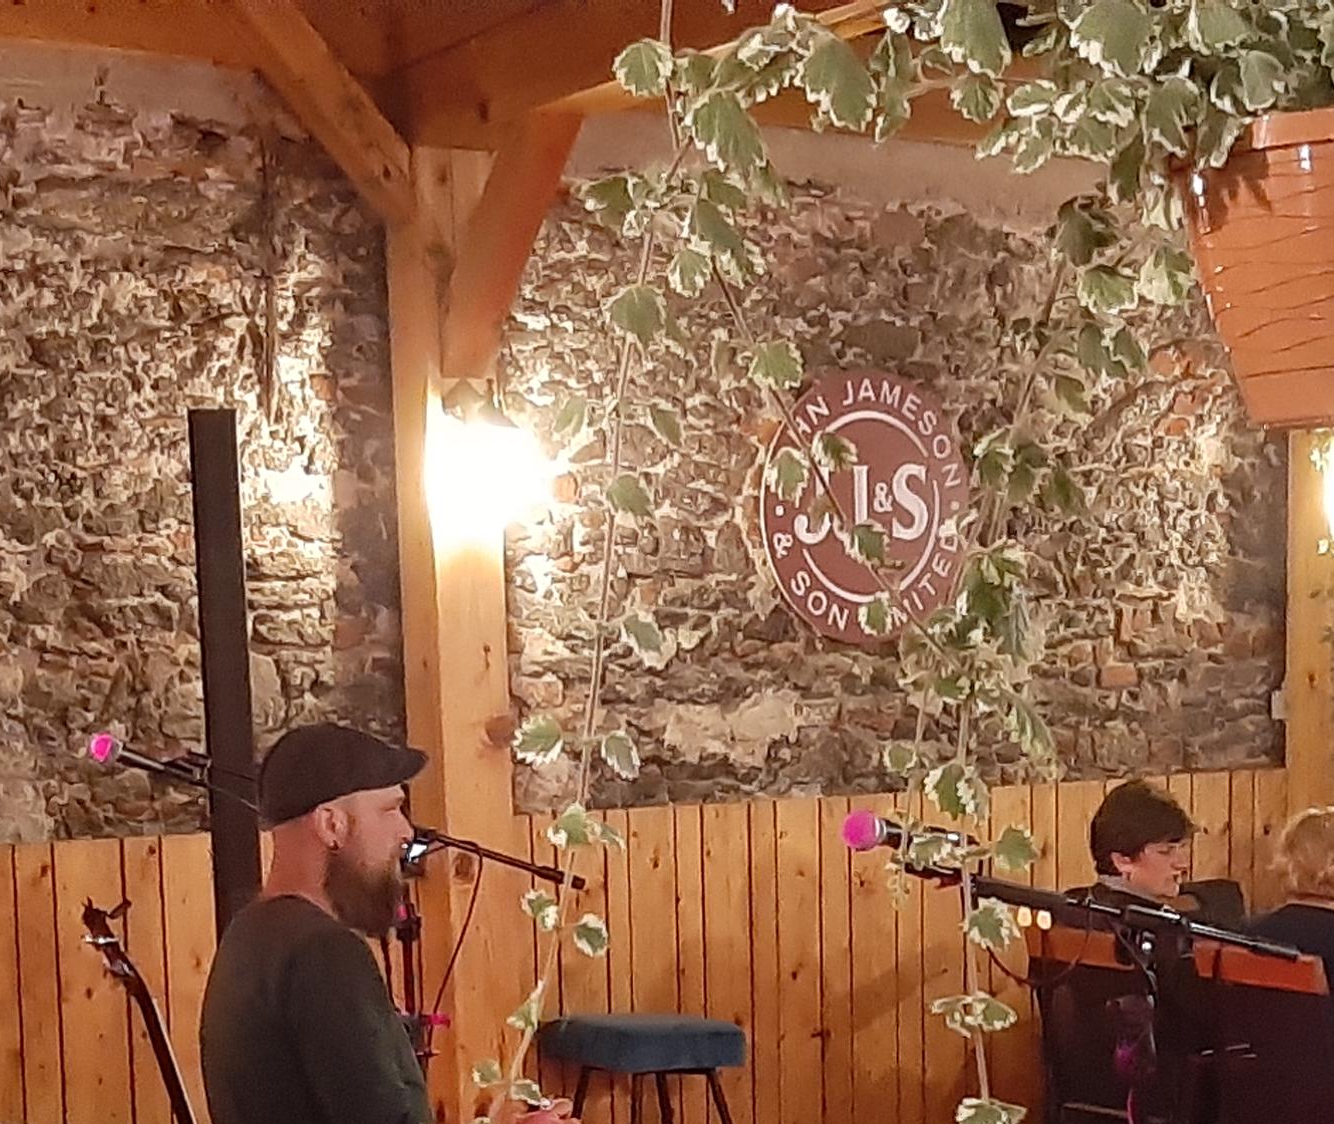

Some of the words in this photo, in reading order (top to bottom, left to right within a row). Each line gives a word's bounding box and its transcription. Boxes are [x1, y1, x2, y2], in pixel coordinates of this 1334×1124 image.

[842, 378, 961, 488] JAMESON
[772, 532, 795, 559] &
[790, 570, 851, 632] SON
